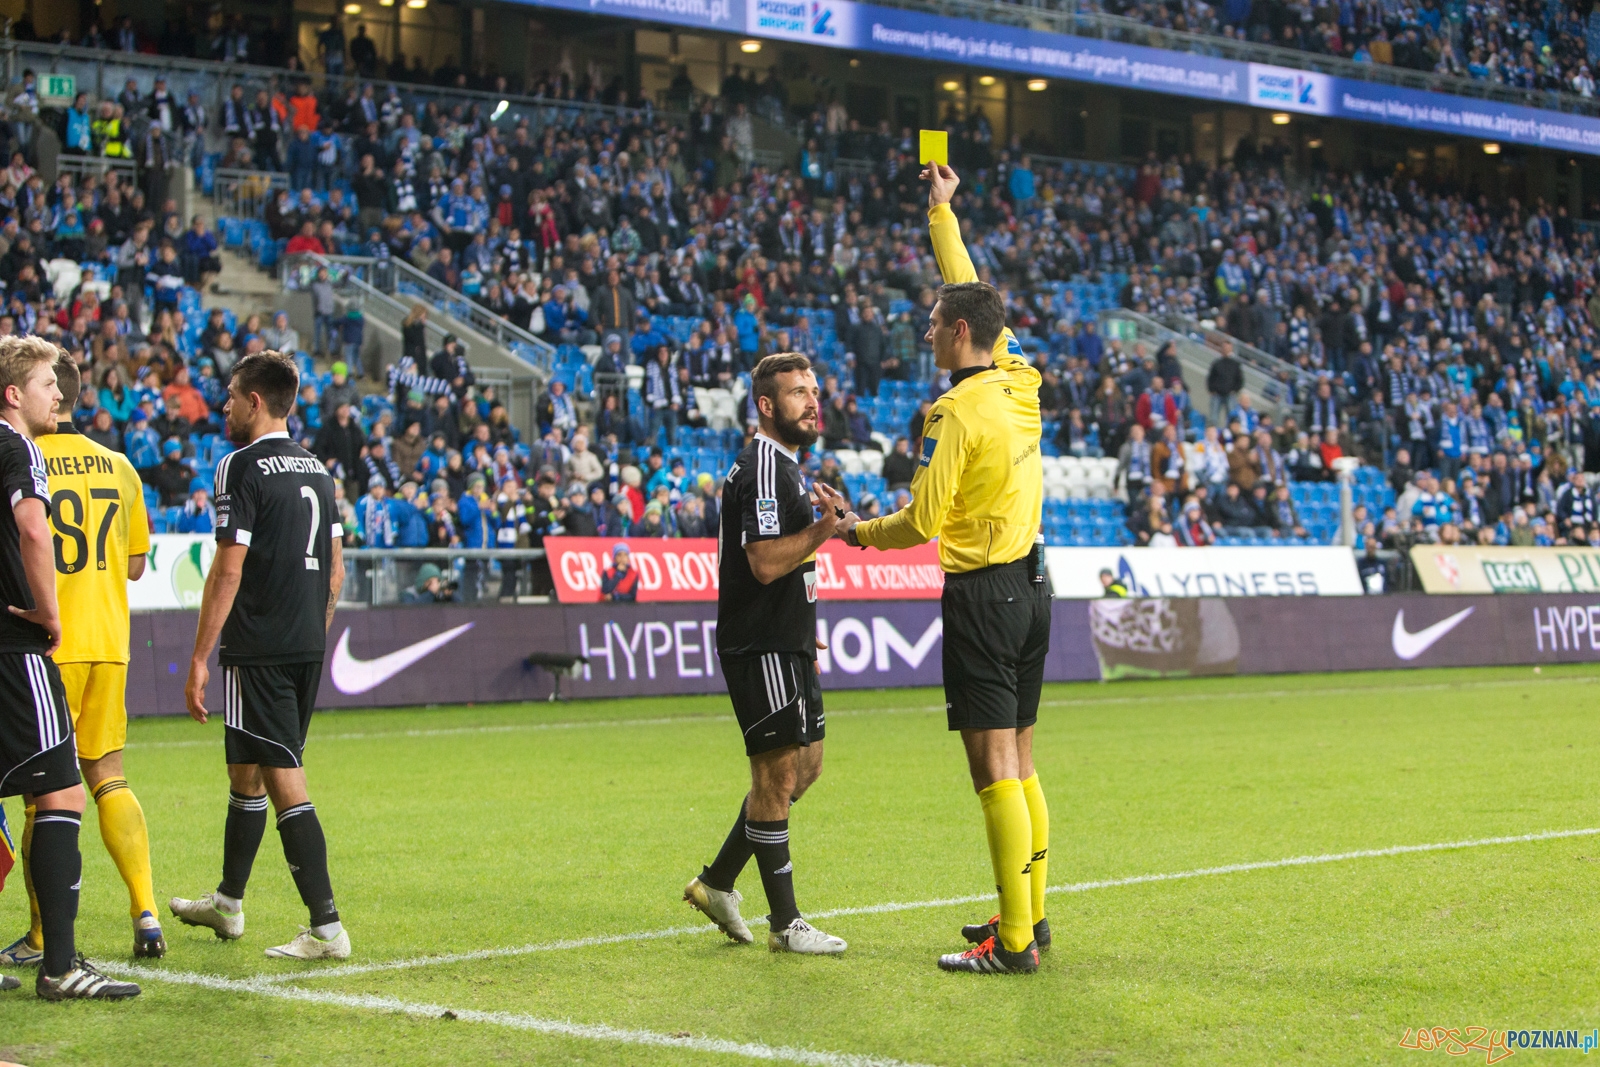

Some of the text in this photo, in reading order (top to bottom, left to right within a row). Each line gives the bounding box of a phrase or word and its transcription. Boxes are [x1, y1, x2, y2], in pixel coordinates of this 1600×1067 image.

[44, 455, 114, 477] KIEŁPIN
[50, 487, 120, 575] 87
[300, 485, 321, 571] 2
[845, 564, 863, 590] W
[1155, 572, 1320, 596] LYONESS
[1484, 561, 1538, 589] LECH
[1533, 605, 1600, 652] HYPE
